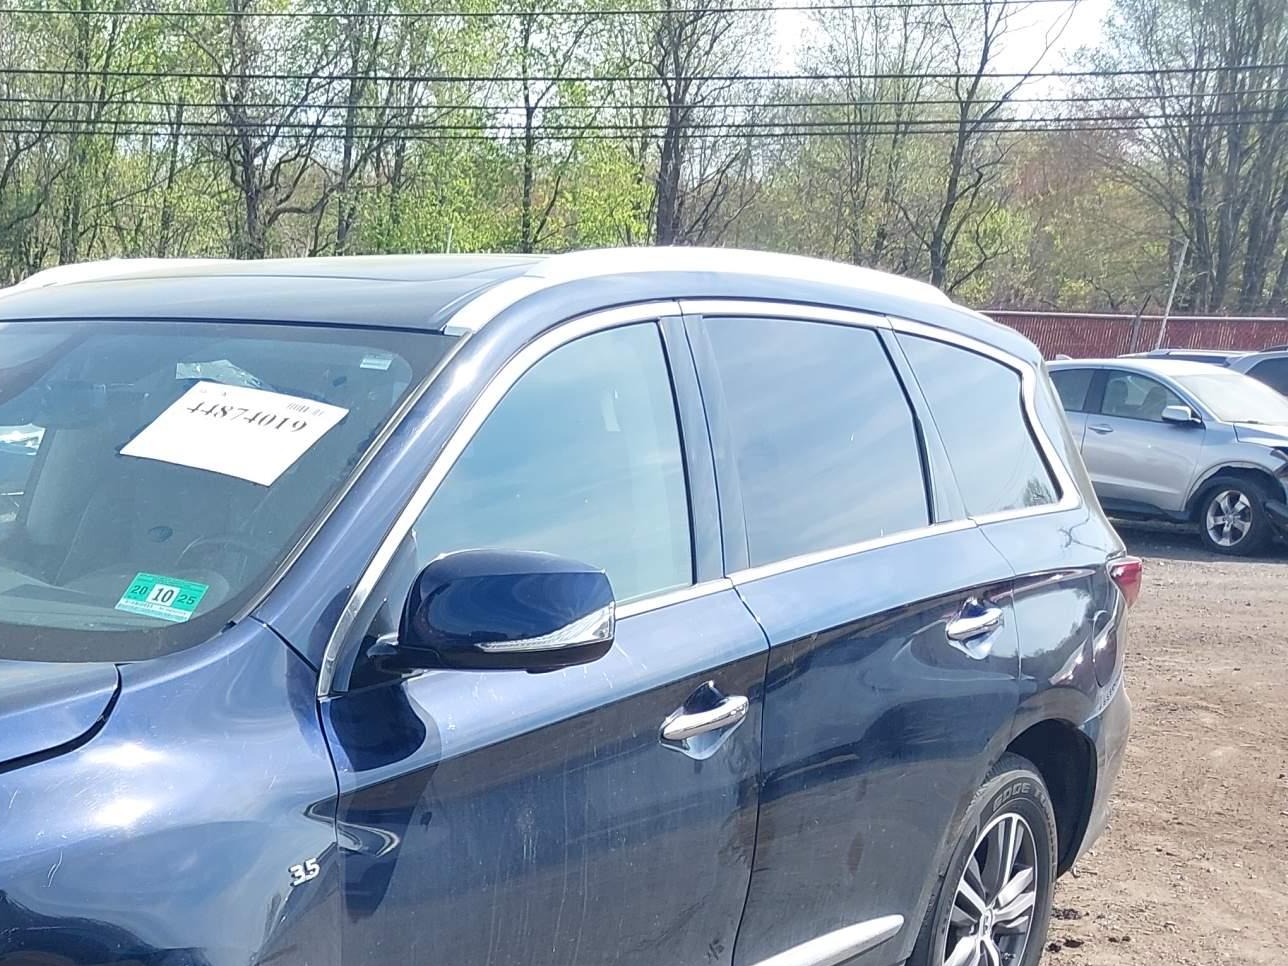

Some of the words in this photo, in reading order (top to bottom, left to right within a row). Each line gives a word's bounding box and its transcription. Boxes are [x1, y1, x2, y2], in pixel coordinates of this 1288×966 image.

[186, 401, 307, 432] 44874019
[131, 585, 149, 595] 20
[152, 587, 174, 603] 10
[178, 594, 197, 605] 25
[992, 782, 1032, 812] EDGE
